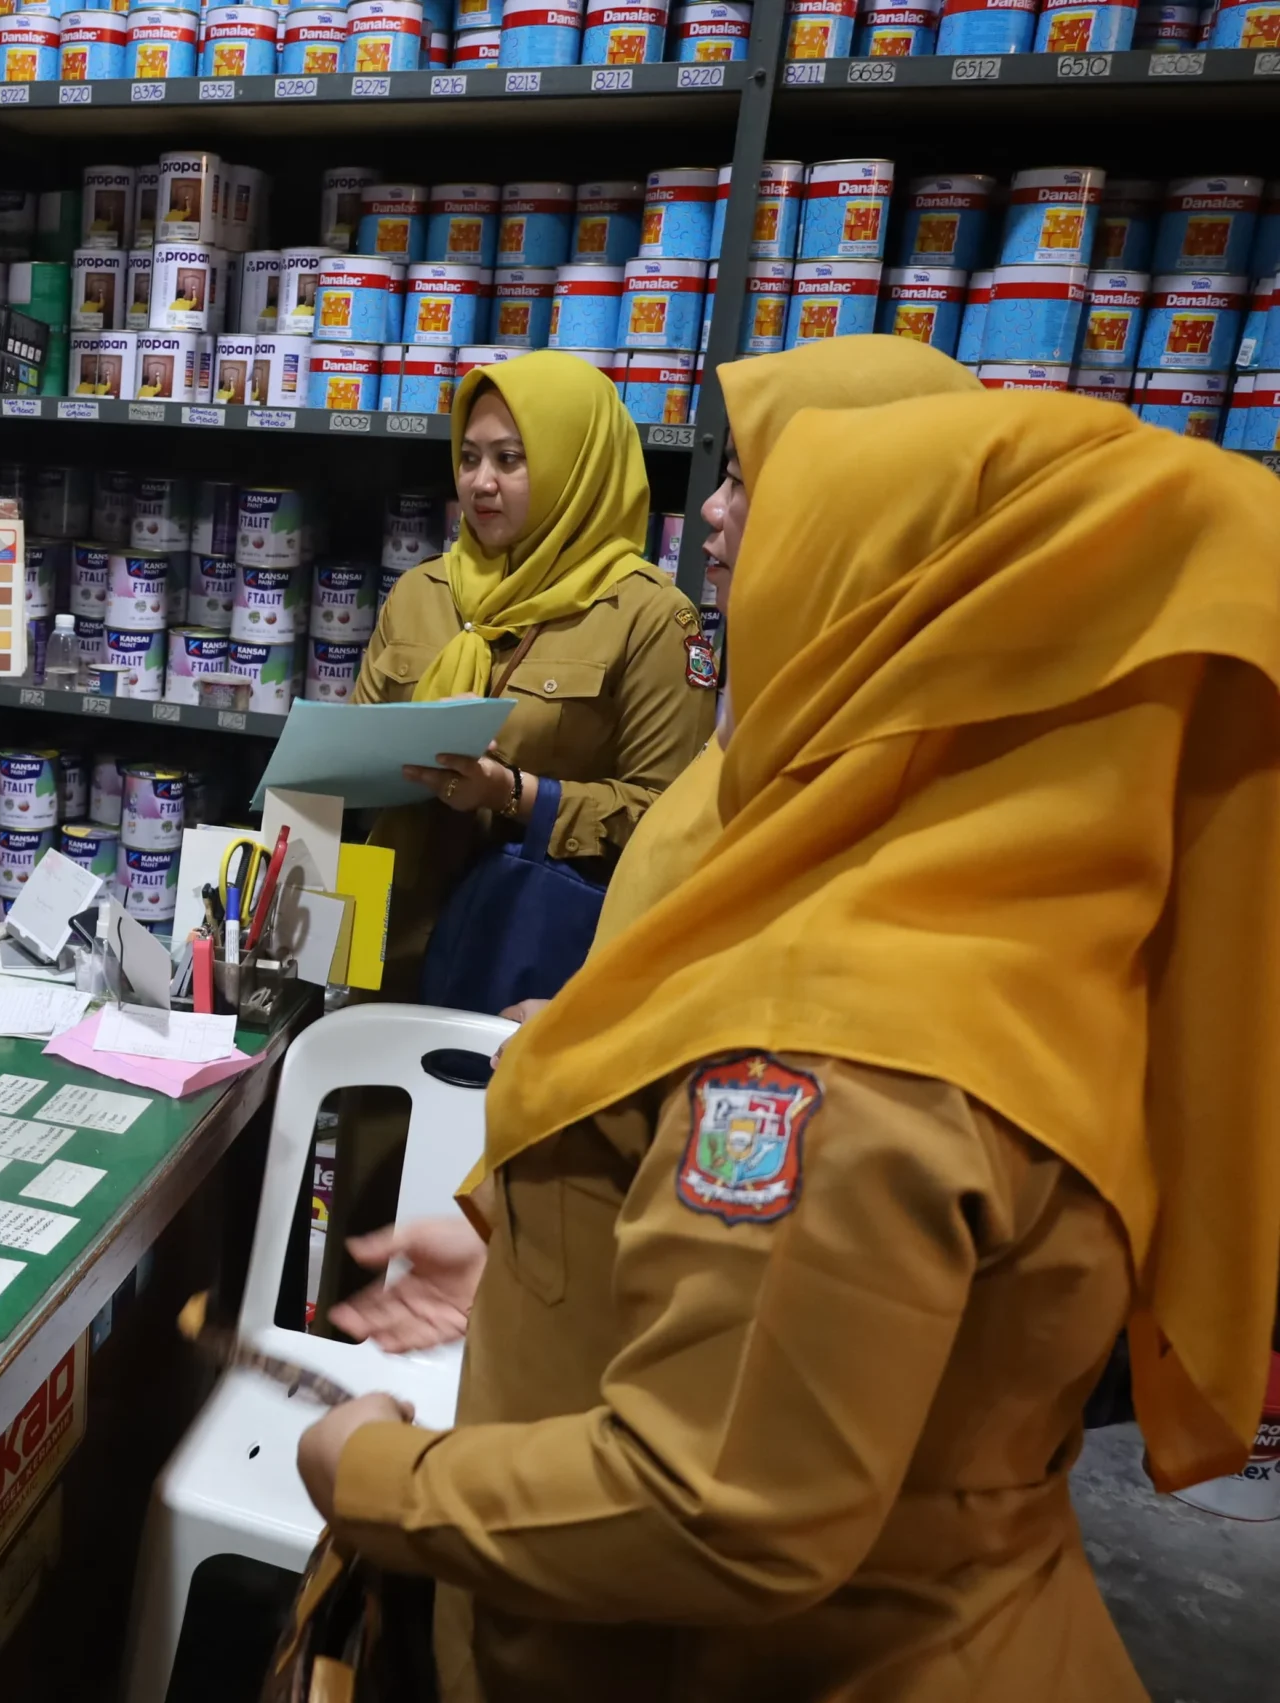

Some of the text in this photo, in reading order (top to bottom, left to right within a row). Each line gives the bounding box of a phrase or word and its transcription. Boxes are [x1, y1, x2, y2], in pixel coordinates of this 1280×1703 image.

[603, 10, 656, 23] Danalac
[867, 11, 923, 26] Danalac
[210, 25, 255, 38] Danalac
[353, 19, 401, 32] Danalac
[690, 22, 742, 36] Danalac
[1, 31, 46, 44] Danalac
[133, 27, 177, 40] Danalac
[299, 28, 346, 41] Danalac
[784, 64, 823, 82] 8211
[849, 63, 894, 82] 6693
[955, 60, 998, 78] 6512
[1060, 56, 1110, 76] 6510
[506, 75, 539, 91] 8213
[595, 70, 632, 89] 8212
[680, 68, 722, 86] 8220
[133, 84, 164, 99] 8376
[200, 85, 232, 98] 8352
[278, 81, 315, 94] 8280
[354, 79, 388, 94] 8275
[432, 77, 464, 93] 8216
[1, 88, 27, 102] 8722
[60, 87, 90, 101] 8720
[838, 181, 888, 195] Danalac
[1038, 188, 1095, 203] Danalac
[165, 251, 210, 264] propan
[319, 273, 362, 286] Danalac
[415, 280, 461, 292] Danalac
[628, 277, 678, 291] Danalac
[497, 284, 540, 297] Danalac
[797, 279, 850, 295] Danalac
[892, 286, 947, 300] Danalac
[1166, 293, 1228, 309] Danalac
[137, 338, 179, 350] propan
[322, 359, 369, 372] Danalac
[188, 416, 219, 425] 69000
[259, 418, 286, 427] 69000
[333, 415, 369, 430] 0009
[389, 416, 425, 432] 0013
[651, 428, 691, 445] 0313
[247, 495, 277, 504] KANSAI
[240, 516, 269, 528] FTALIT
[257, 571, 289, 581] KANSAI
[247, 592, 282, 605] FTALIT
[119, 635, 149, 644] KANSAI
[110, 654, 143, 667] FTALIT
[84, 698, 108, 713] 125
[9, 762, 41, 773] KANSAI
[1, 782, 33, 795] FTALIT
[139, 854, 171, 864] KANSAI
[130, 873, 165, 887] FTALIT
[26, 1415, 73, 1476] KERAMIK
